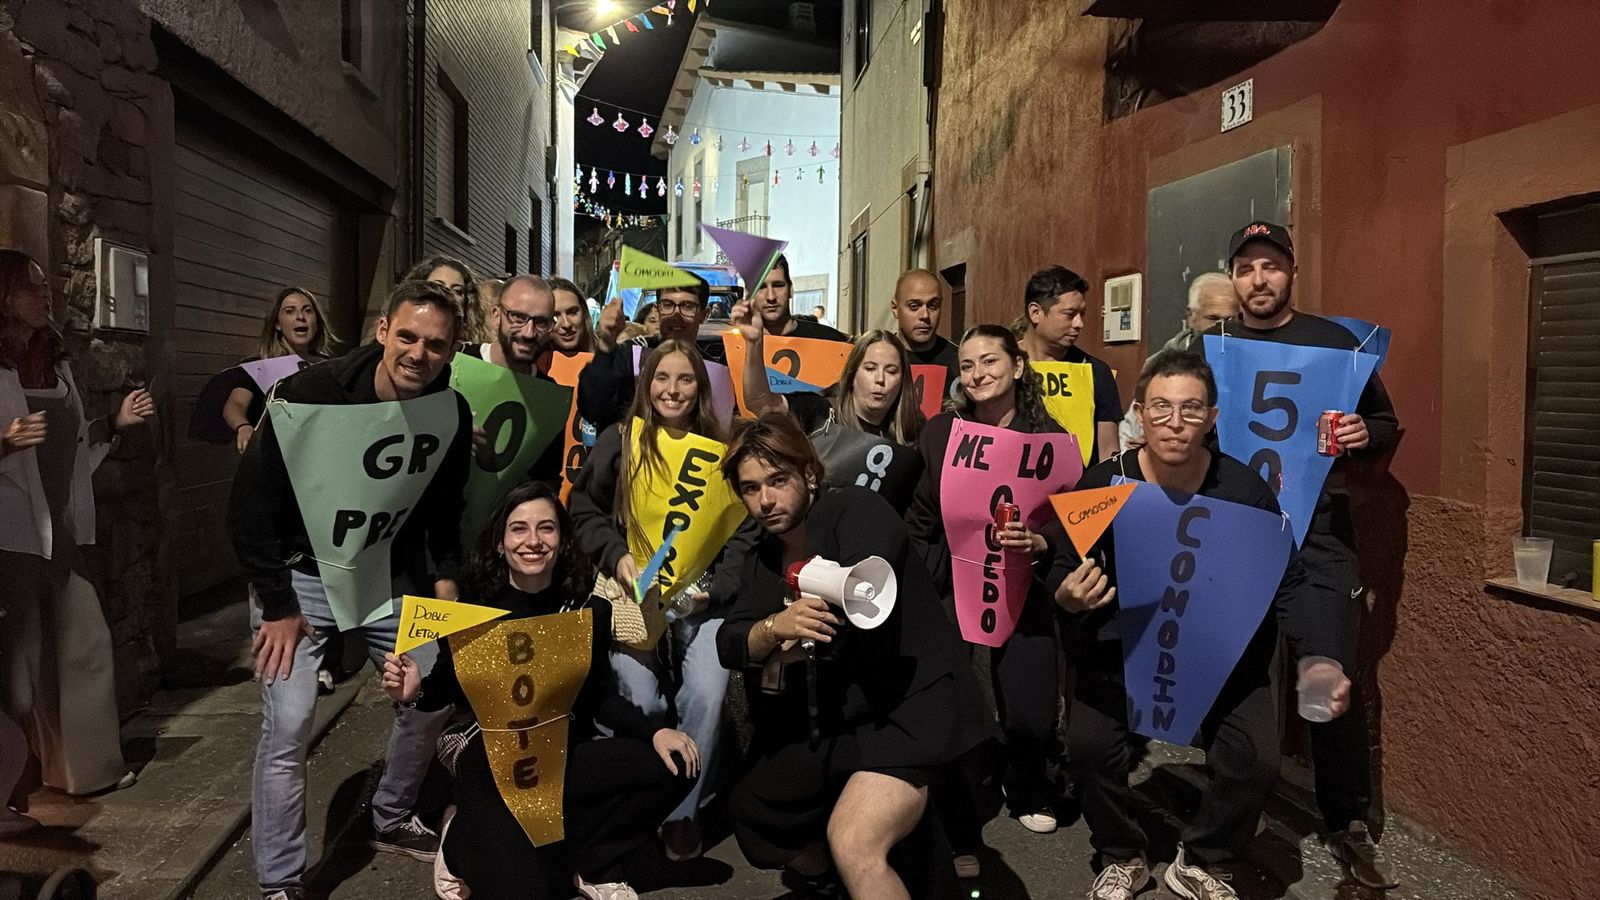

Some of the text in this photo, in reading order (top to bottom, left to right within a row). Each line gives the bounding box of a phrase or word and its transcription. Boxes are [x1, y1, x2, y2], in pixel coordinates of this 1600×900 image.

[1228, 90, 1246, 123] 33
[951, 433, 1054, 480] ME LO
[408, 621, 441, 640] LETRA
[507, 631, 540, 791] BOTE
